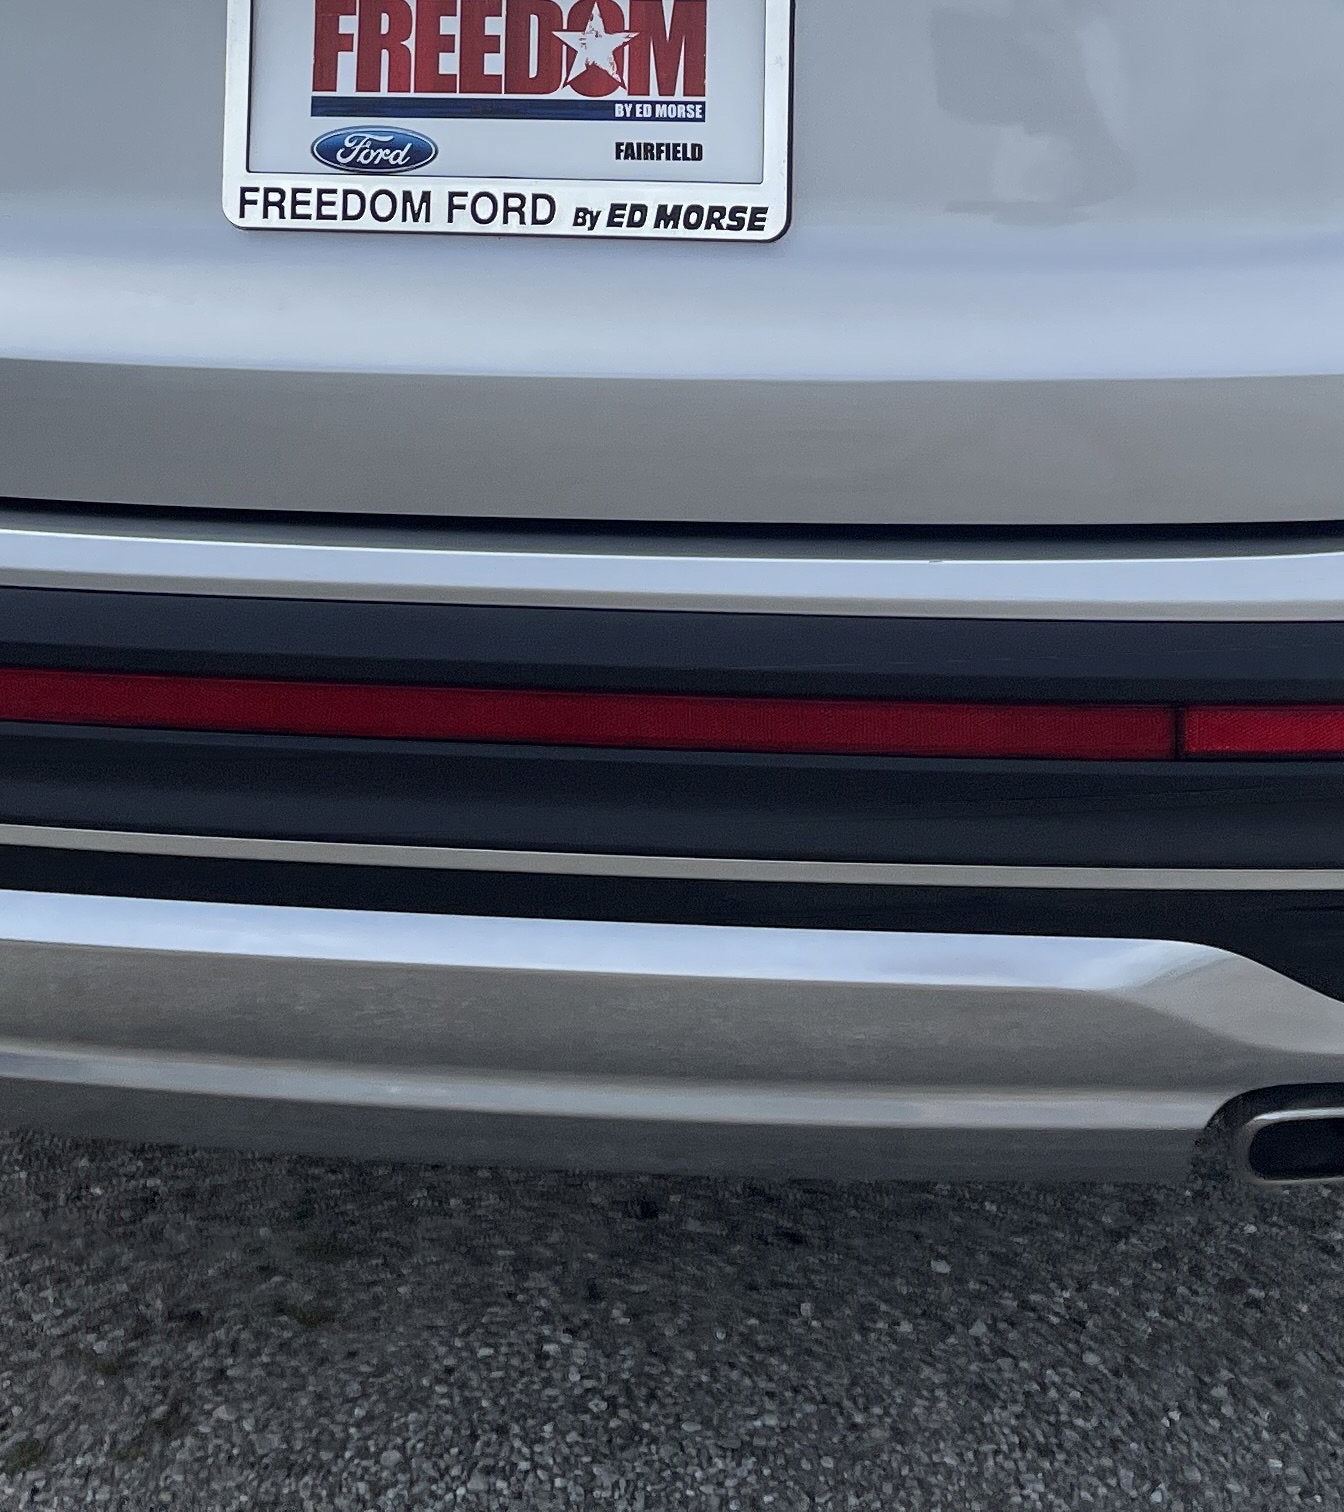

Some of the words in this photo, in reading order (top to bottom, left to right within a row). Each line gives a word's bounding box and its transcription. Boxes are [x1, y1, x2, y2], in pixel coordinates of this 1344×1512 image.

[615, 103, 633, 117] BY
[635, 104, 653, 117] ED
[655, 104, 703, 119] MORSE
[336, 133, 410, 166] Ford
[615, 141, 704, 162] FAIRFIELD
[238, 187, 432, 224] FREEDOM
[447, 190, 557, 227] FORD
[572, 207, 601, 231] By
[607, 203, 648, 229] ED
[653, 203, 769, 232] MORSE
